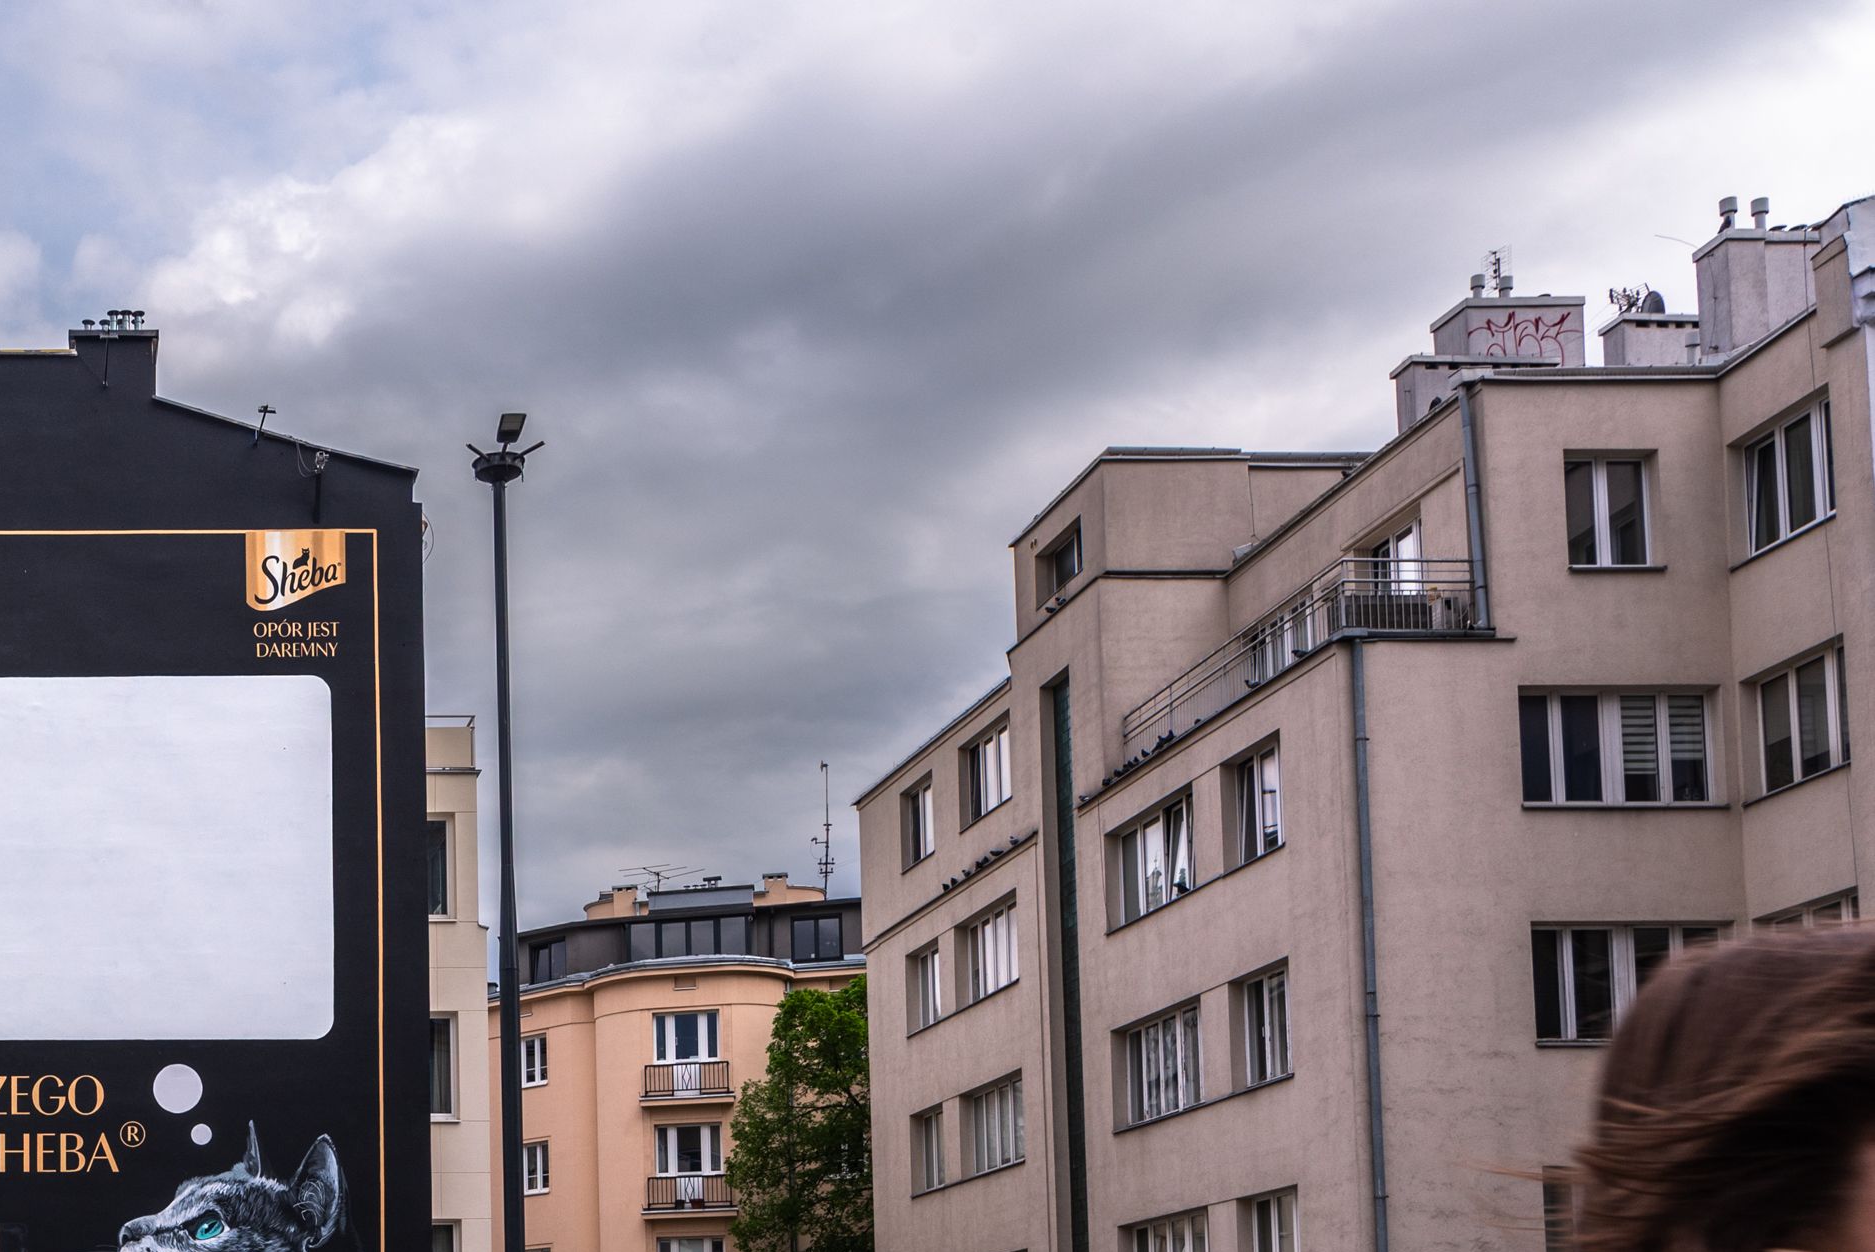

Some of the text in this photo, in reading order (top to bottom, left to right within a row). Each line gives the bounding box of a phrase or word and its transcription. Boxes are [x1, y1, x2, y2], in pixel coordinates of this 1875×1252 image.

[254, 555, 339, 605] Sheba
[253, 618, 340, 640] OPÓR JEST
[256, 643, 338, 658] DAREMNY
